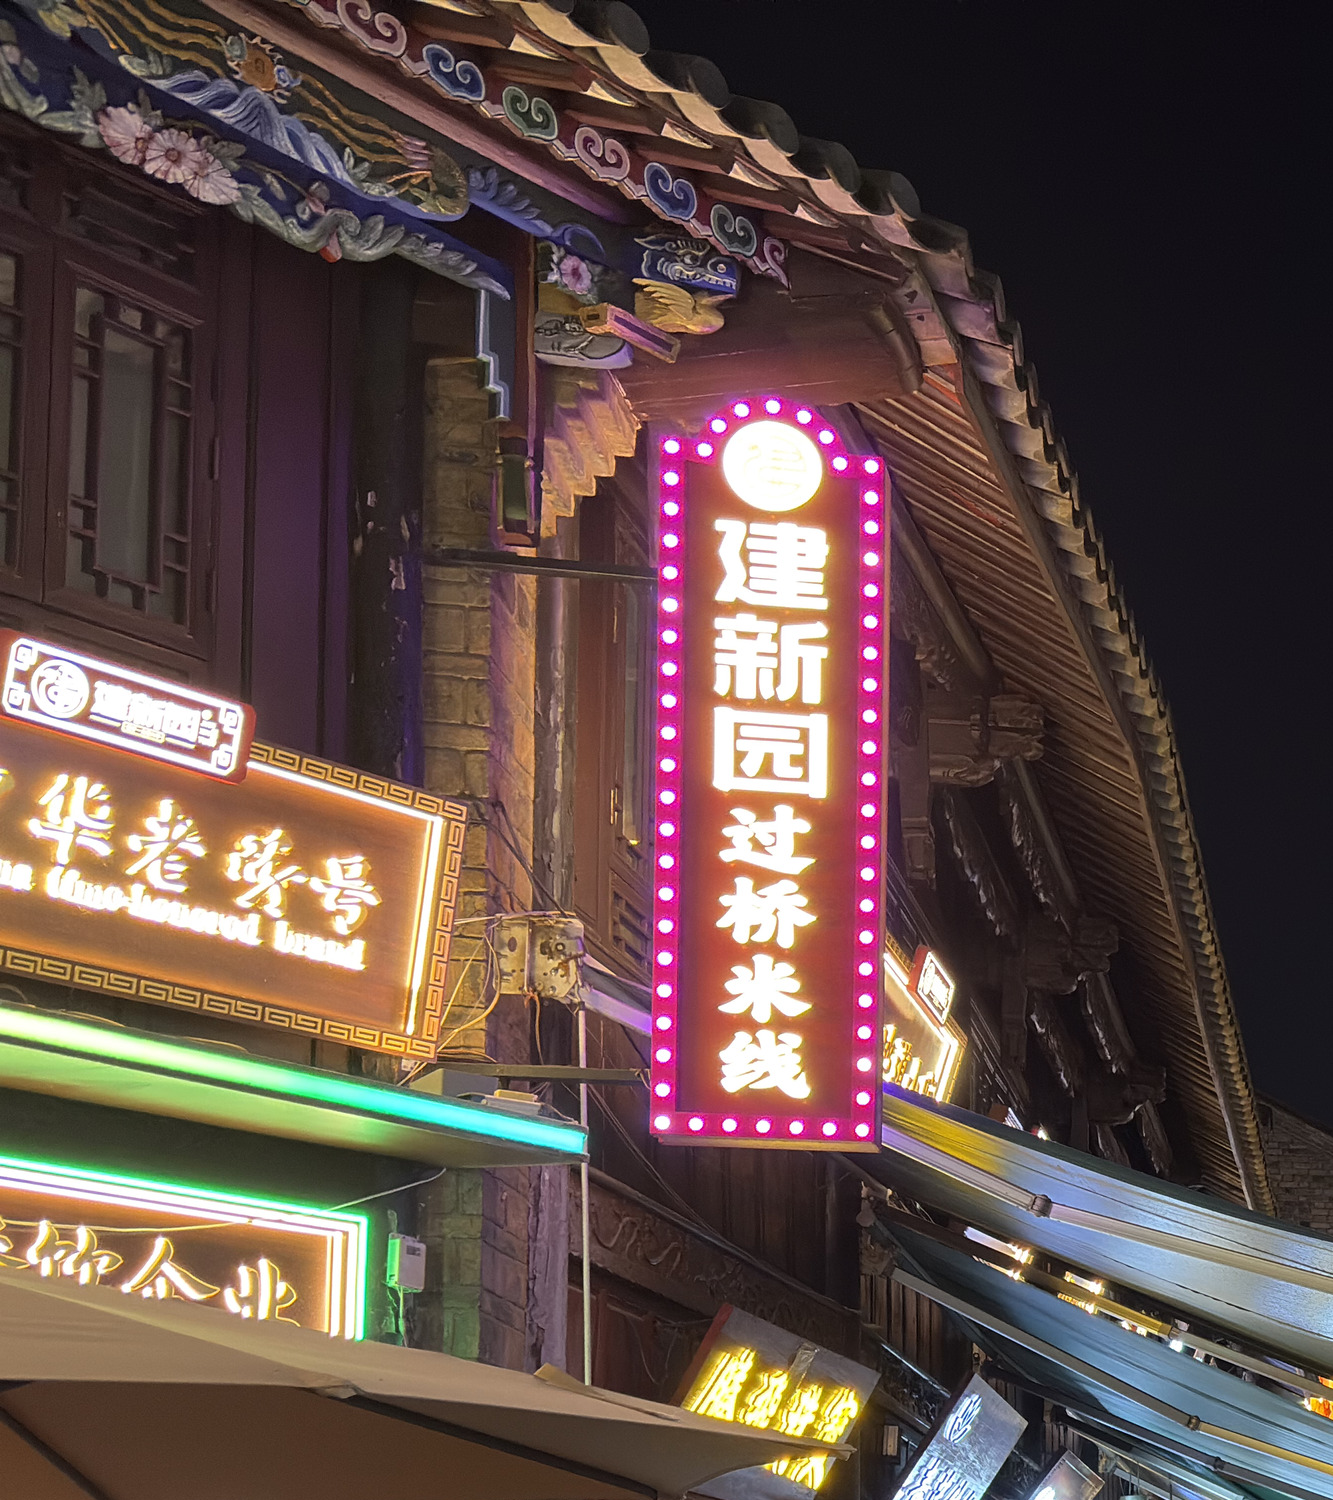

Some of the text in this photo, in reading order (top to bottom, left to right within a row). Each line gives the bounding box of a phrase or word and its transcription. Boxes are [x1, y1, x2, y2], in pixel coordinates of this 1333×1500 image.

[0, 768, 383, 936] 华老字号
[274, 920, 367, 971] brand
